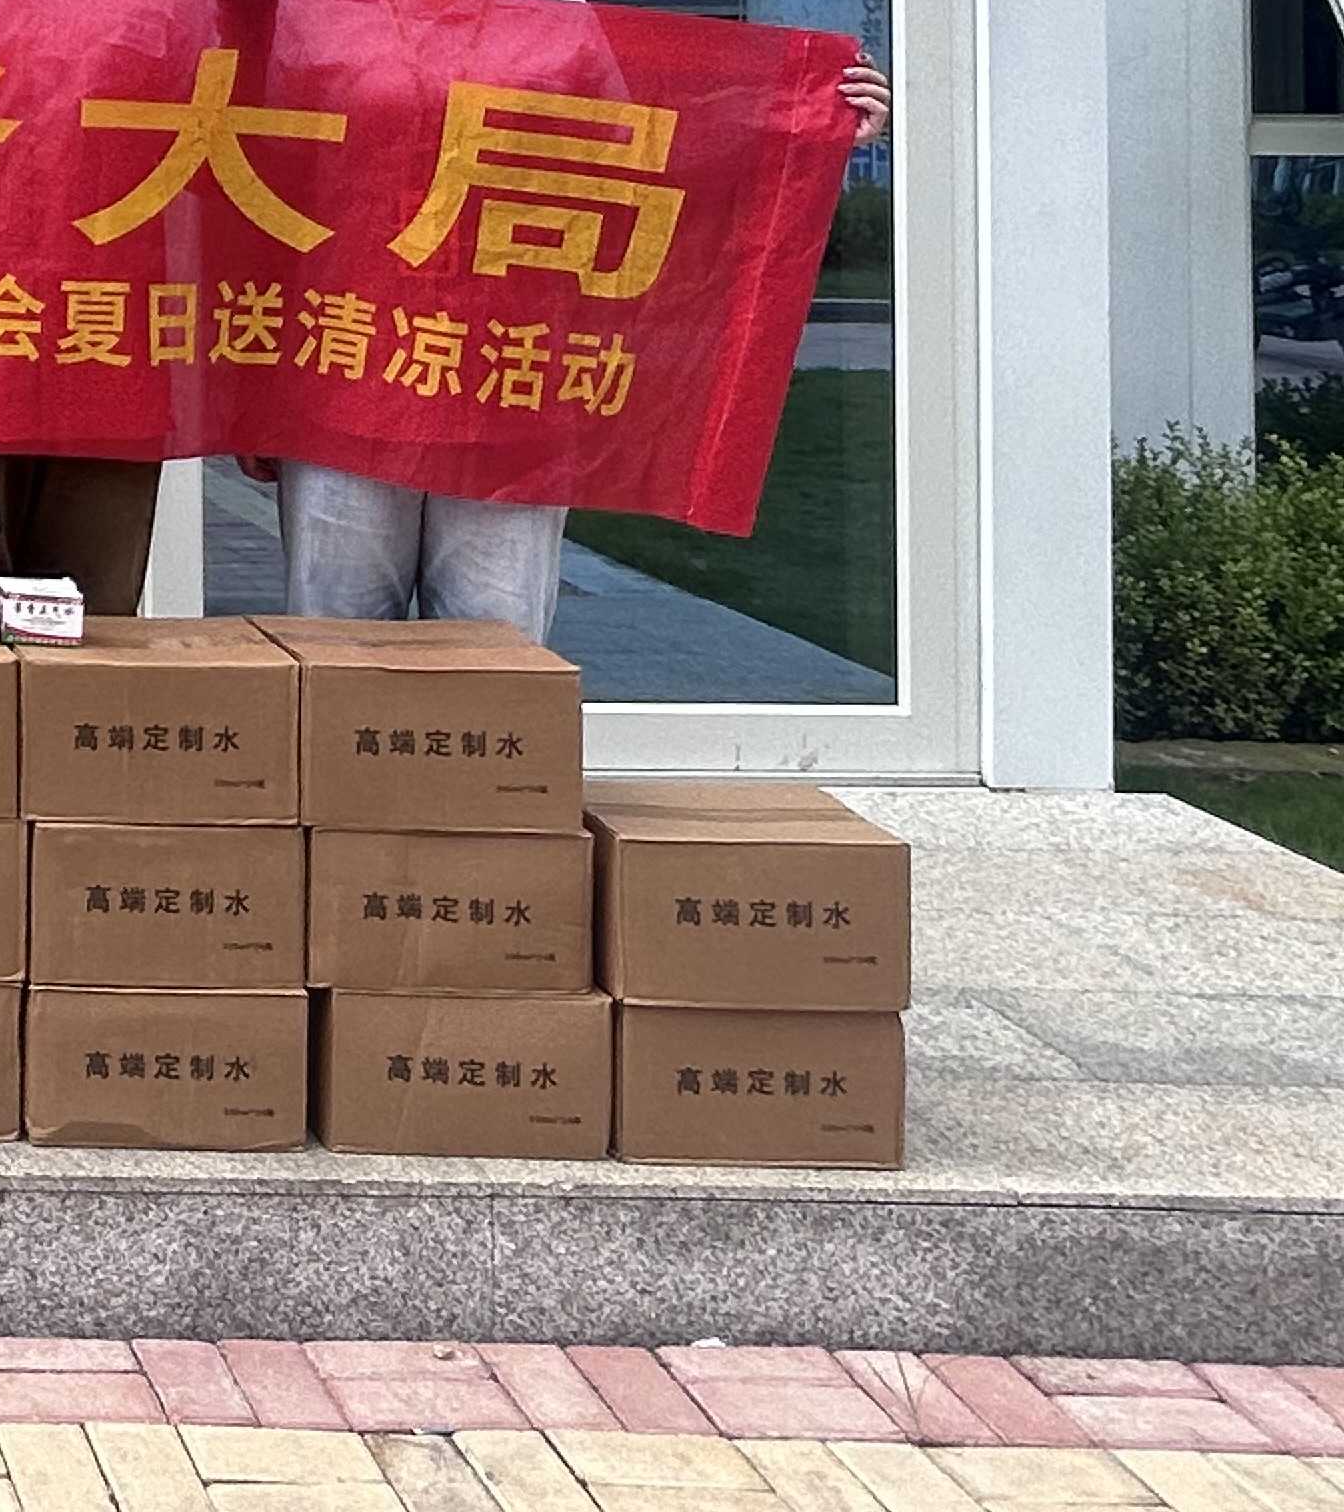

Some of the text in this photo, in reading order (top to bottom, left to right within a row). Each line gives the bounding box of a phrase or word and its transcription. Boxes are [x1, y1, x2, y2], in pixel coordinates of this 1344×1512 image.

[73, 721, 240, 754] 高端定制水
[354, 725, 524, 760] 高端定制水
[85, 883, 251, 917] 高端定制水
[362, 890, 531, 928] 高端定制水
[674, 895, 851, 930] 高端定制水
[84, 1049, 250, 1083] 高端定制水
[386, 1053, 558, 1090] 高端定制水
[676, 1065, 848, 1097] 高端定制水
